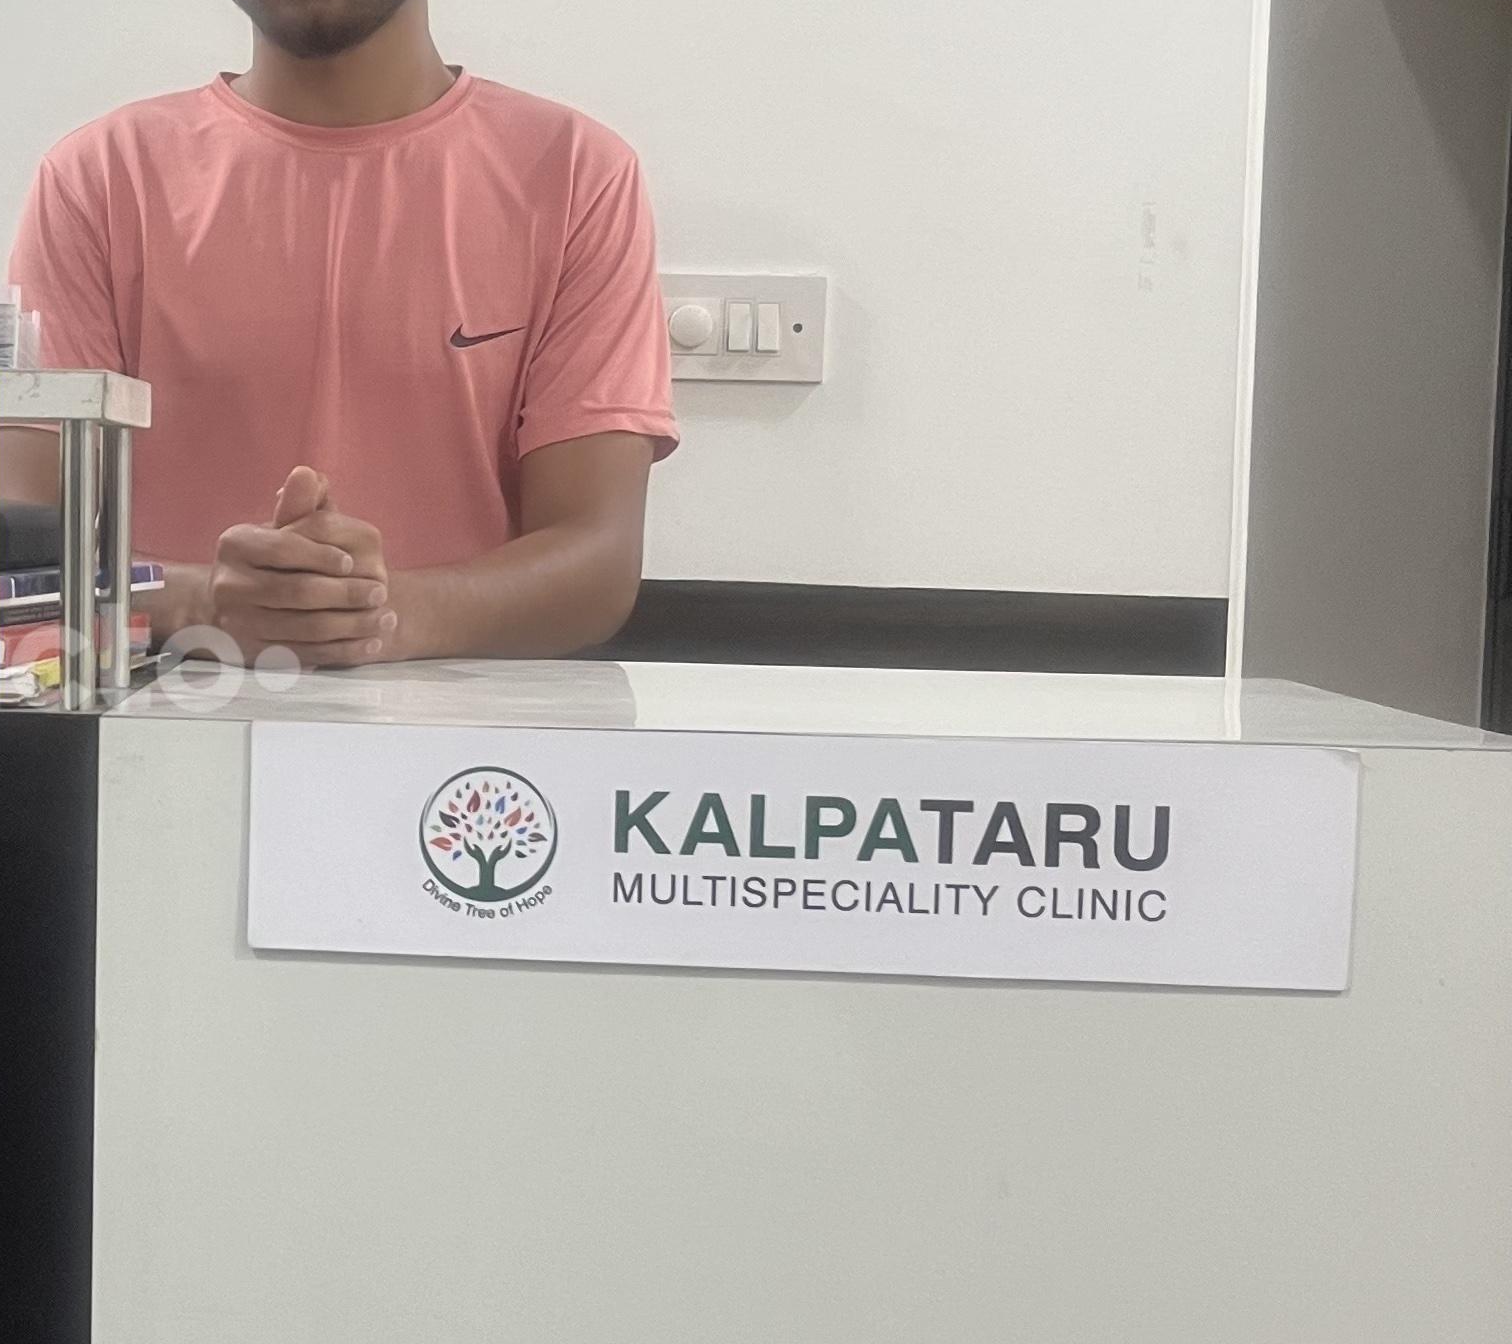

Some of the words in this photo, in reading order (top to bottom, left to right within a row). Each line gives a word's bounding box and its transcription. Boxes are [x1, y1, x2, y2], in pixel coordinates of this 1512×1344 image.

[613, 790, 1172, 873] KALPATARU
[422, 879, 461, 912] Divine
[465, 902, 495, 919] Tree
[499, 902, 514, 917] of
[515, 885, 553, 913] Hope
[613, 873, 998, 918] MULTISPECIALITY
[1017, 885, 1168, 923] CLINIC
